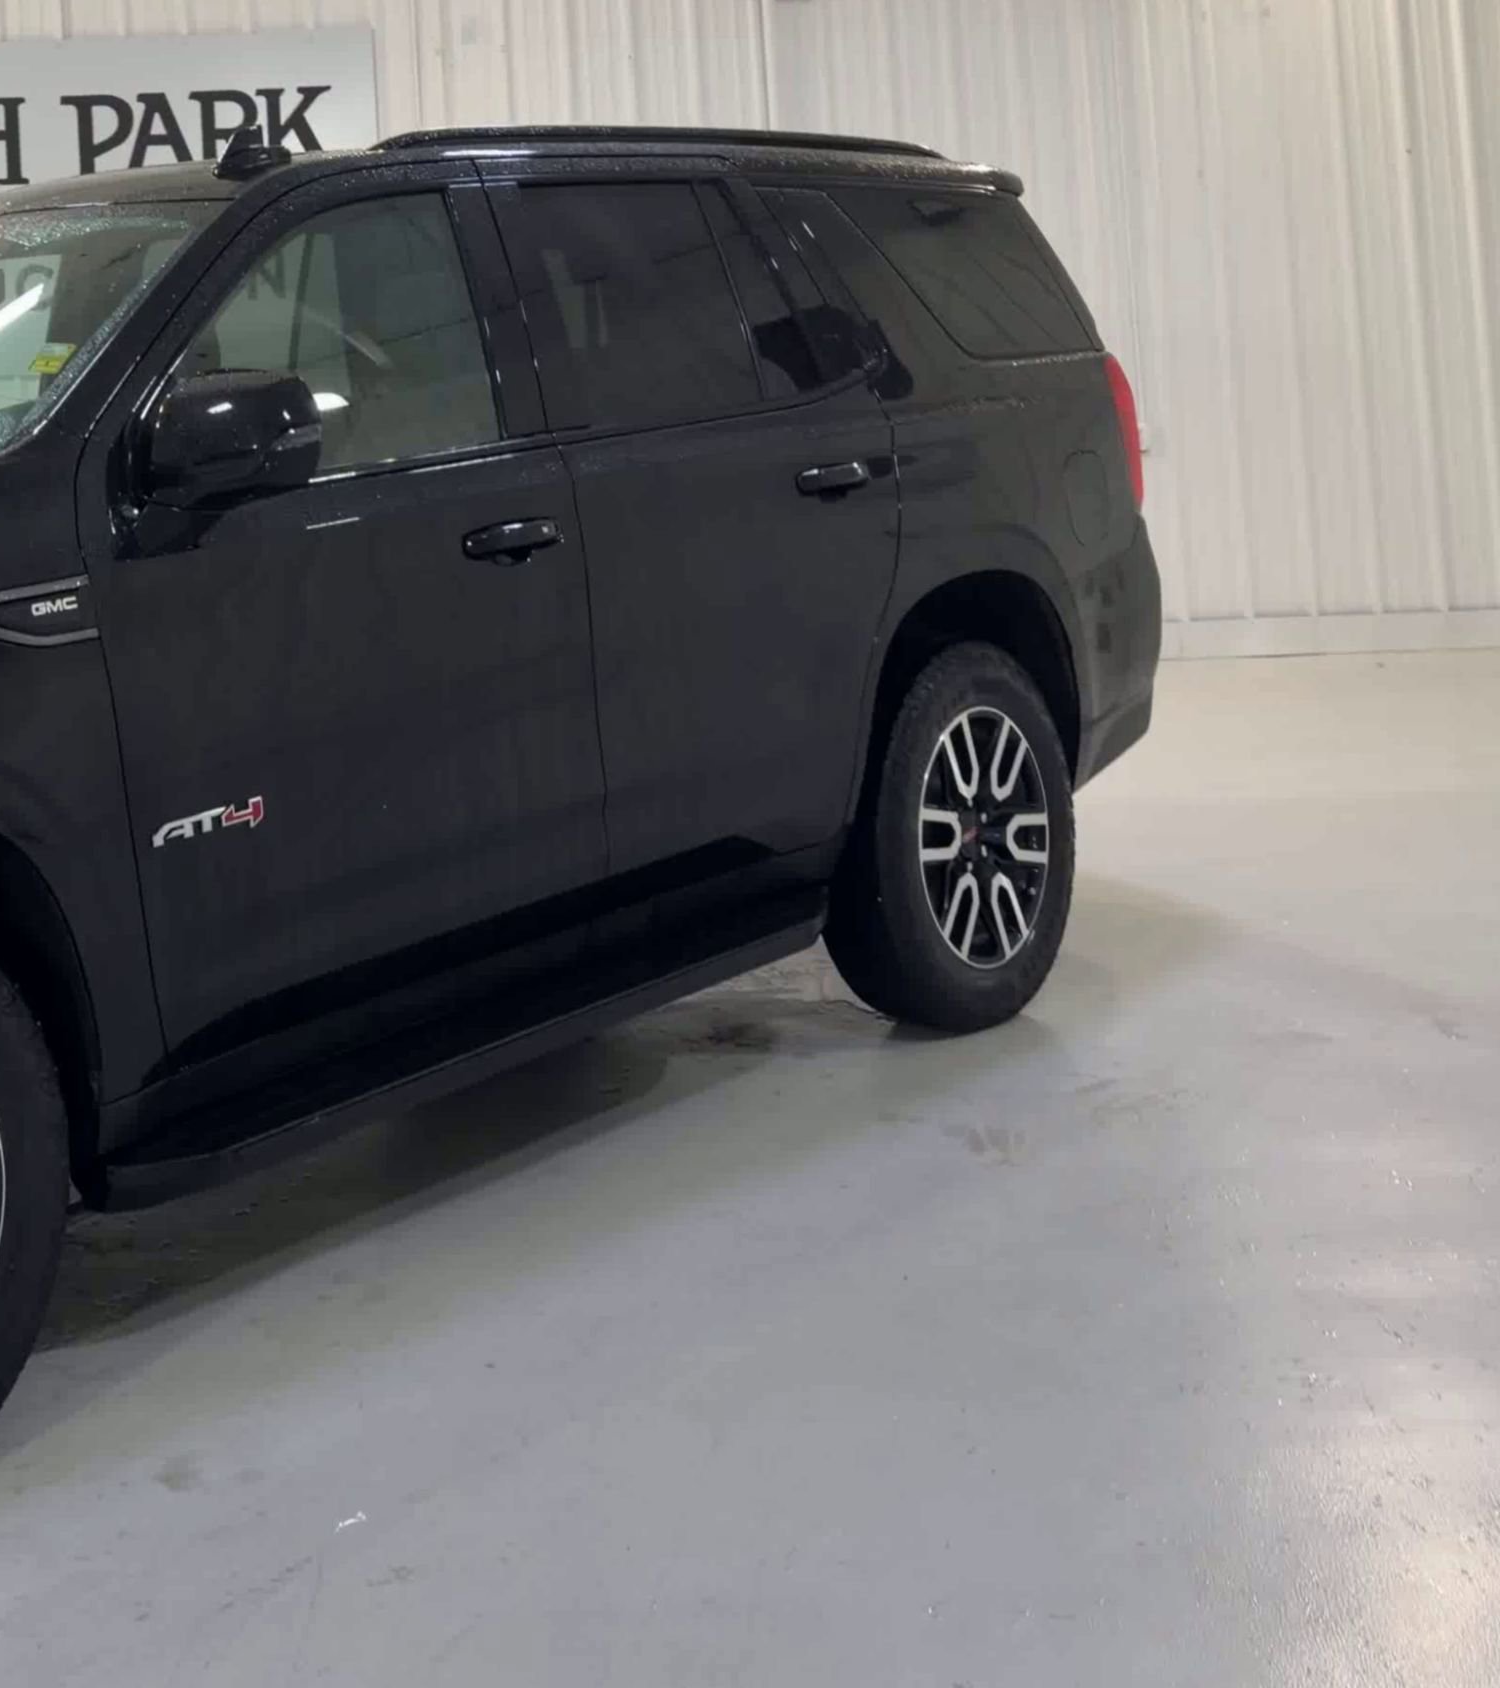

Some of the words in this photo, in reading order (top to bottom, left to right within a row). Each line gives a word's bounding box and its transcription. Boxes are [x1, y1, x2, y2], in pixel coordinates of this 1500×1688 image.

[60, 85, 332, 176] PARK
[30, 596, 79, 617] GMC
[151, 795, 264, 848] AT4
